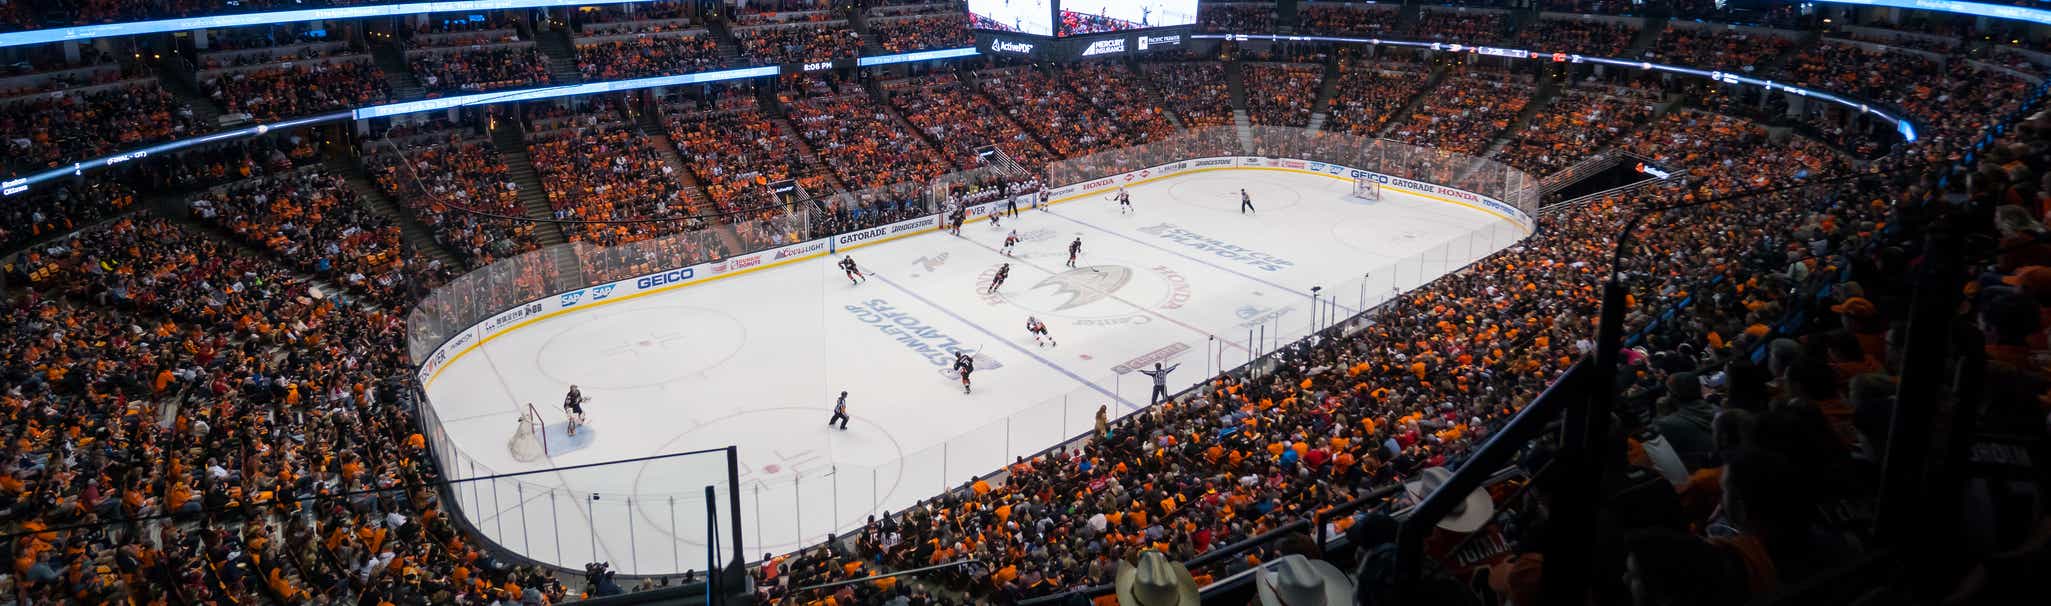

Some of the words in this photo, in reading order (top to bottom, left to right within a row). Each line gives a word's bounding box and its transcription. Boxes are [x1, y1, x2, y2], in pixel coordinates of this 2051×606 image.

[821, 61, 833, 70] PM
[2, 177, 27, 188] Boston
[1350, 169, 1388, 184] GEICO
[1083, 178, 1114, 190] HONDA
[1392, 178, 1434, 193] GATORADE
[1437, 187, 1479, 202] HONDA
[891, 218, 935, 234] BRIDGESTONE
[840, 227, 887, 245] GATORADE
[804, 242, 825, 253] LIGHT
[637, 267, 694, 290] GEICO
[561, 291, 583, 305] SAP
[593, 285, 615, 298] SAP
